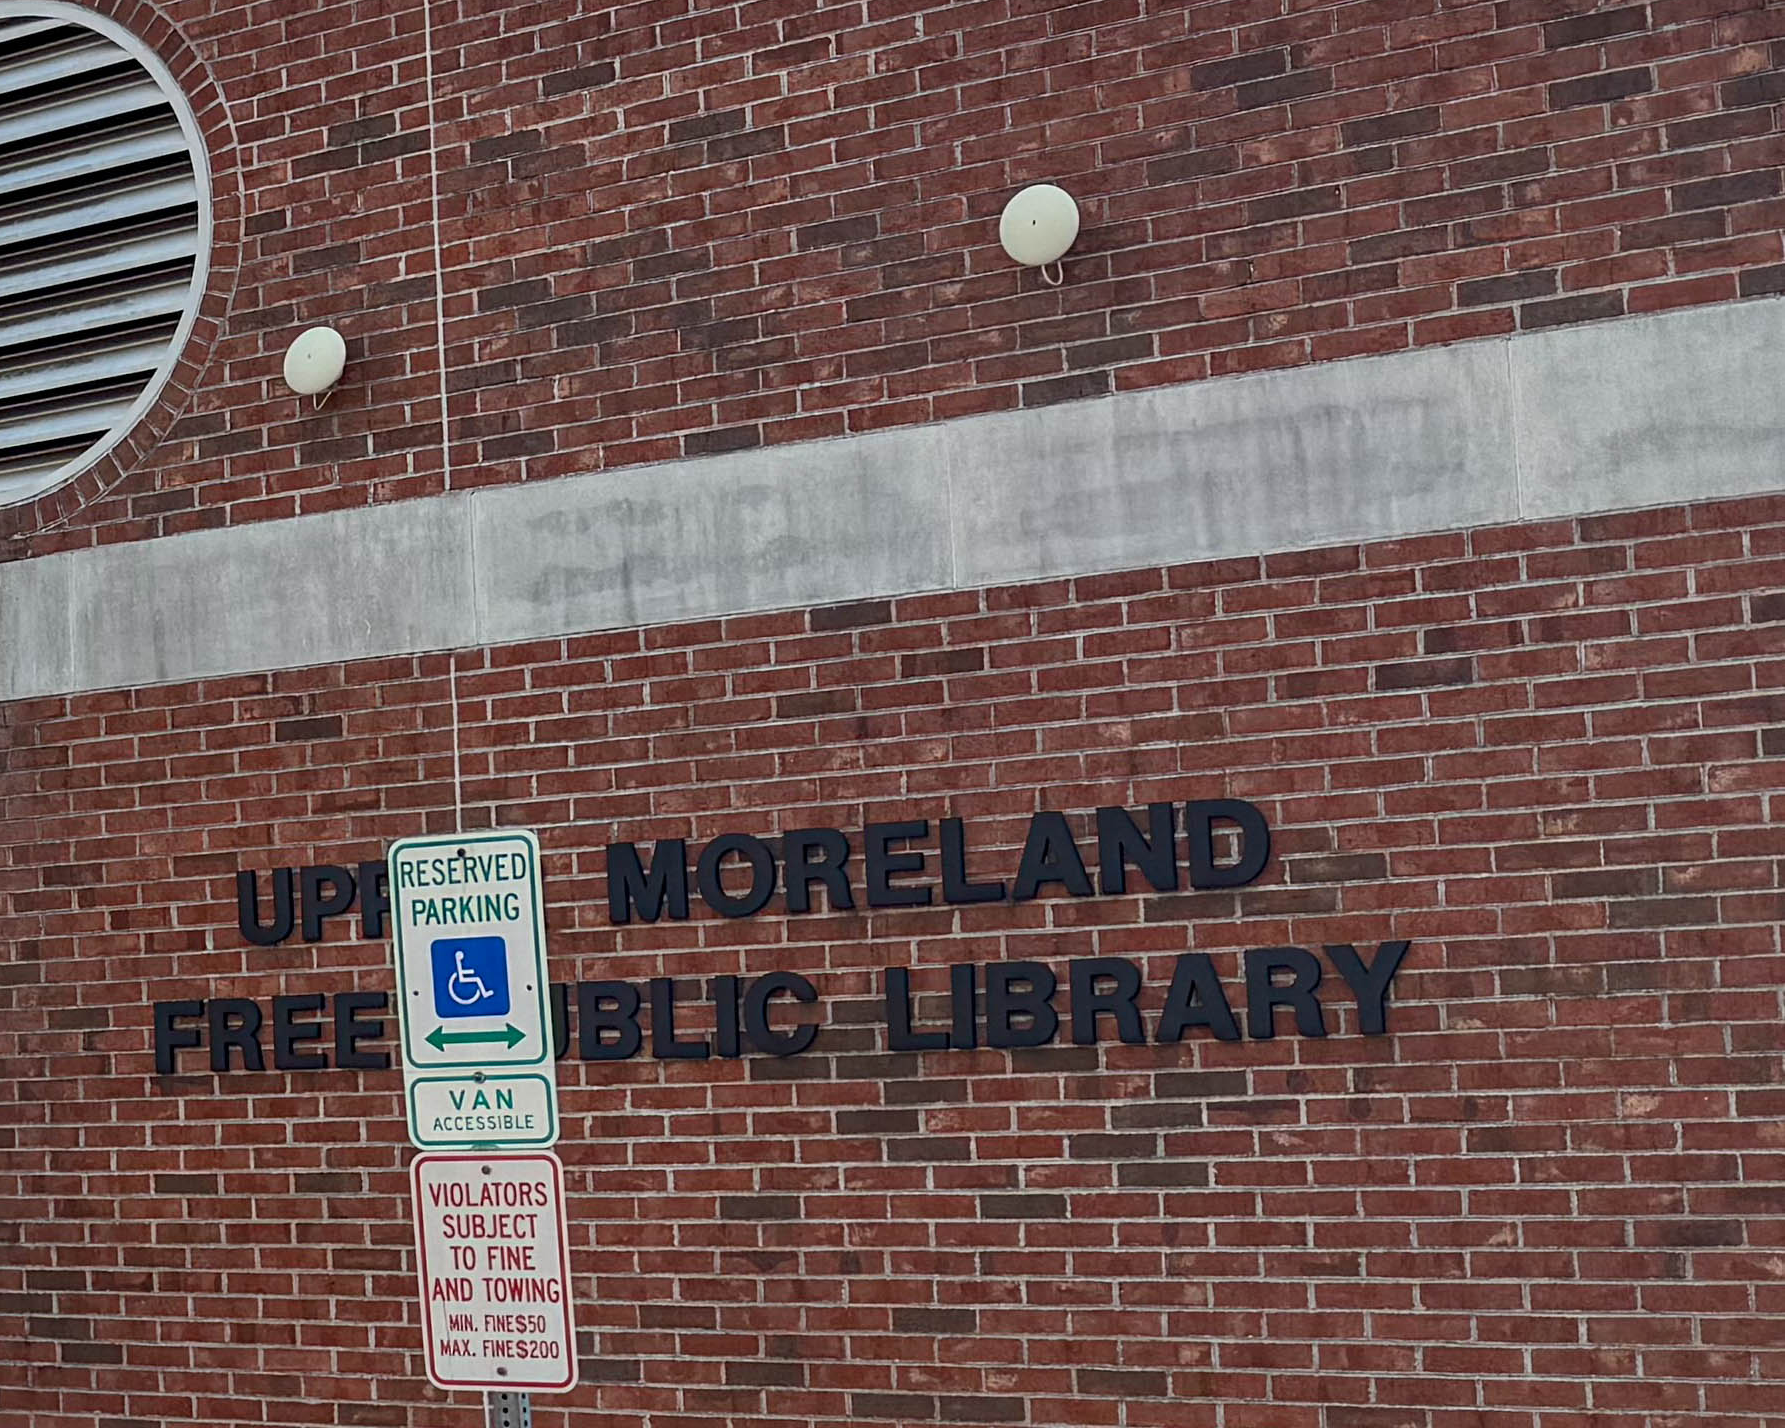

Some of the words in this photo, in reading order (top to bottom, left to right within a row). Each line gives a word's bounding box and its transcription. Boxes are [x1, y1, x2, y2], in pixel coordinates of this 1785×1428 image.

[236, 862, 391, 947] UPP
[606, 798, 1271, 925] MORELAND
[400, 853, 526, 888] RESERVED
[411, 892, 520, 927] PARKING
[153, 991, 391, 1074] FREE
[549, 970, 819, 1061] BLIC
[884, 940, 1412, 1053] LIBRARY
[449, 1088, 514, 1111] VAN
[433, 1114, 535, 1132] ACCESSIBLE
[428, 1181, 548, 1207] VIOLATORS
[442, 1213, 538, 1239] SUBJECT
[449, 1245, 476, 1270] TO
[487, 1245, 536, 1270] FINE
[432, 1277, 474, 1302] AND
[482, 1277, 560, 1303] TOWING
[448, 1313, 478, 1332] MIN.
[440, 1339, 476, 1357] MAX.
